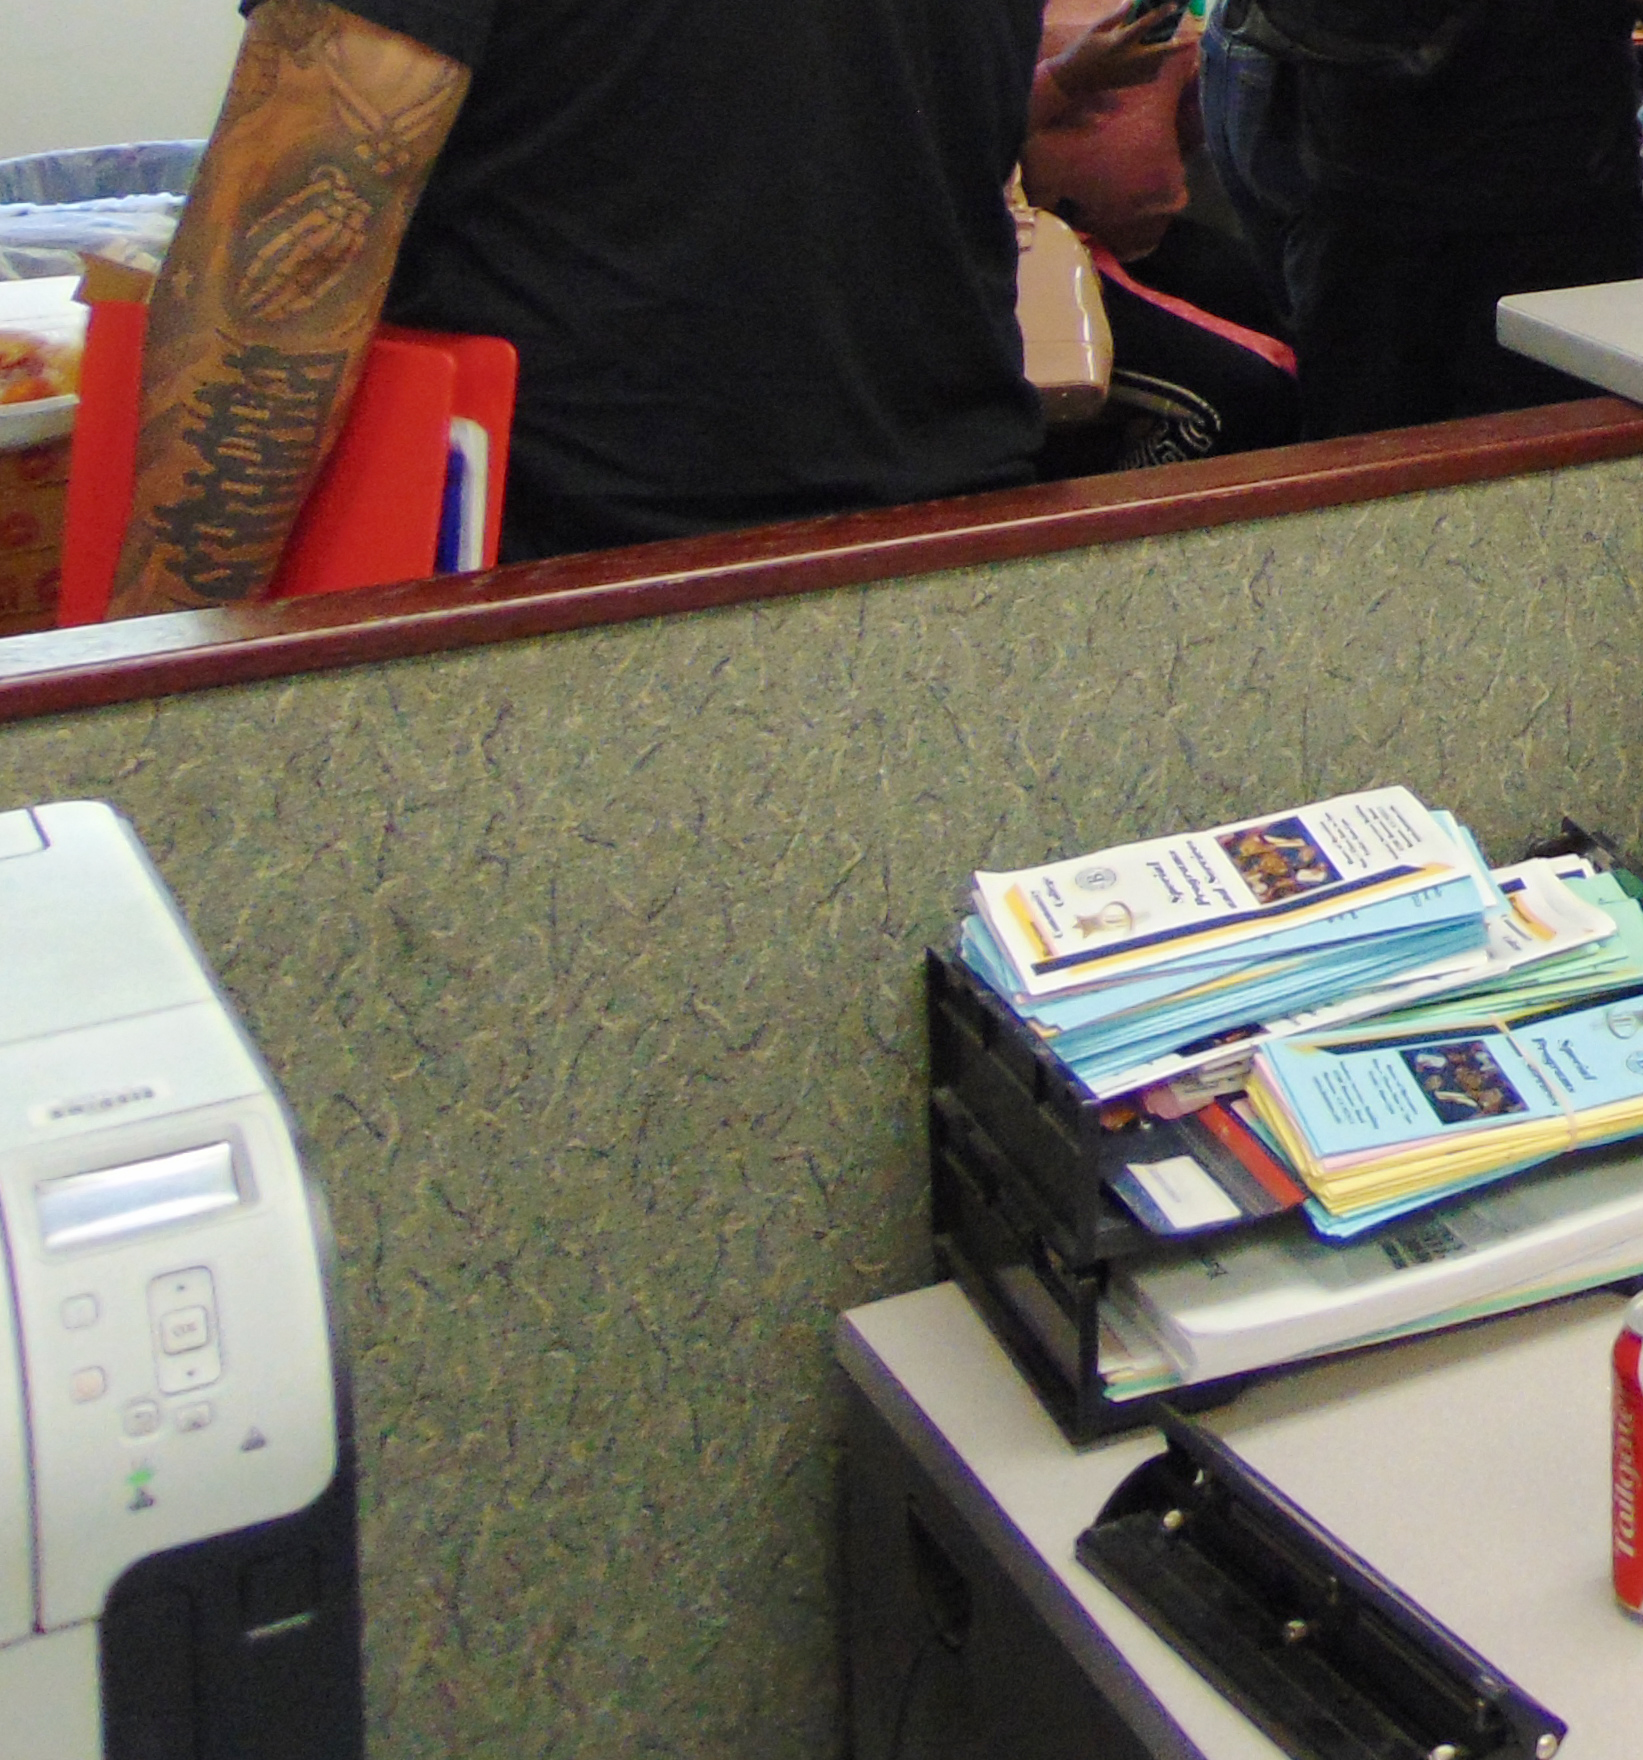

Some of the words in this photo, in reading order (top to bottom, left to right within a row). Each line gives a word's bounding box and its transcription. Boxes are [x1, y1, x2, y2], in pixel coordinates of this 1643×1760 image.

[1146, 861, 1185, 903] Special
[1168, 850, 1212, 906] Programs
[1186, 840, 1219, 884] Services
[1532, 1038, 1577, 1094] Programs
[1557, 1038, 1596, 1081] Special
